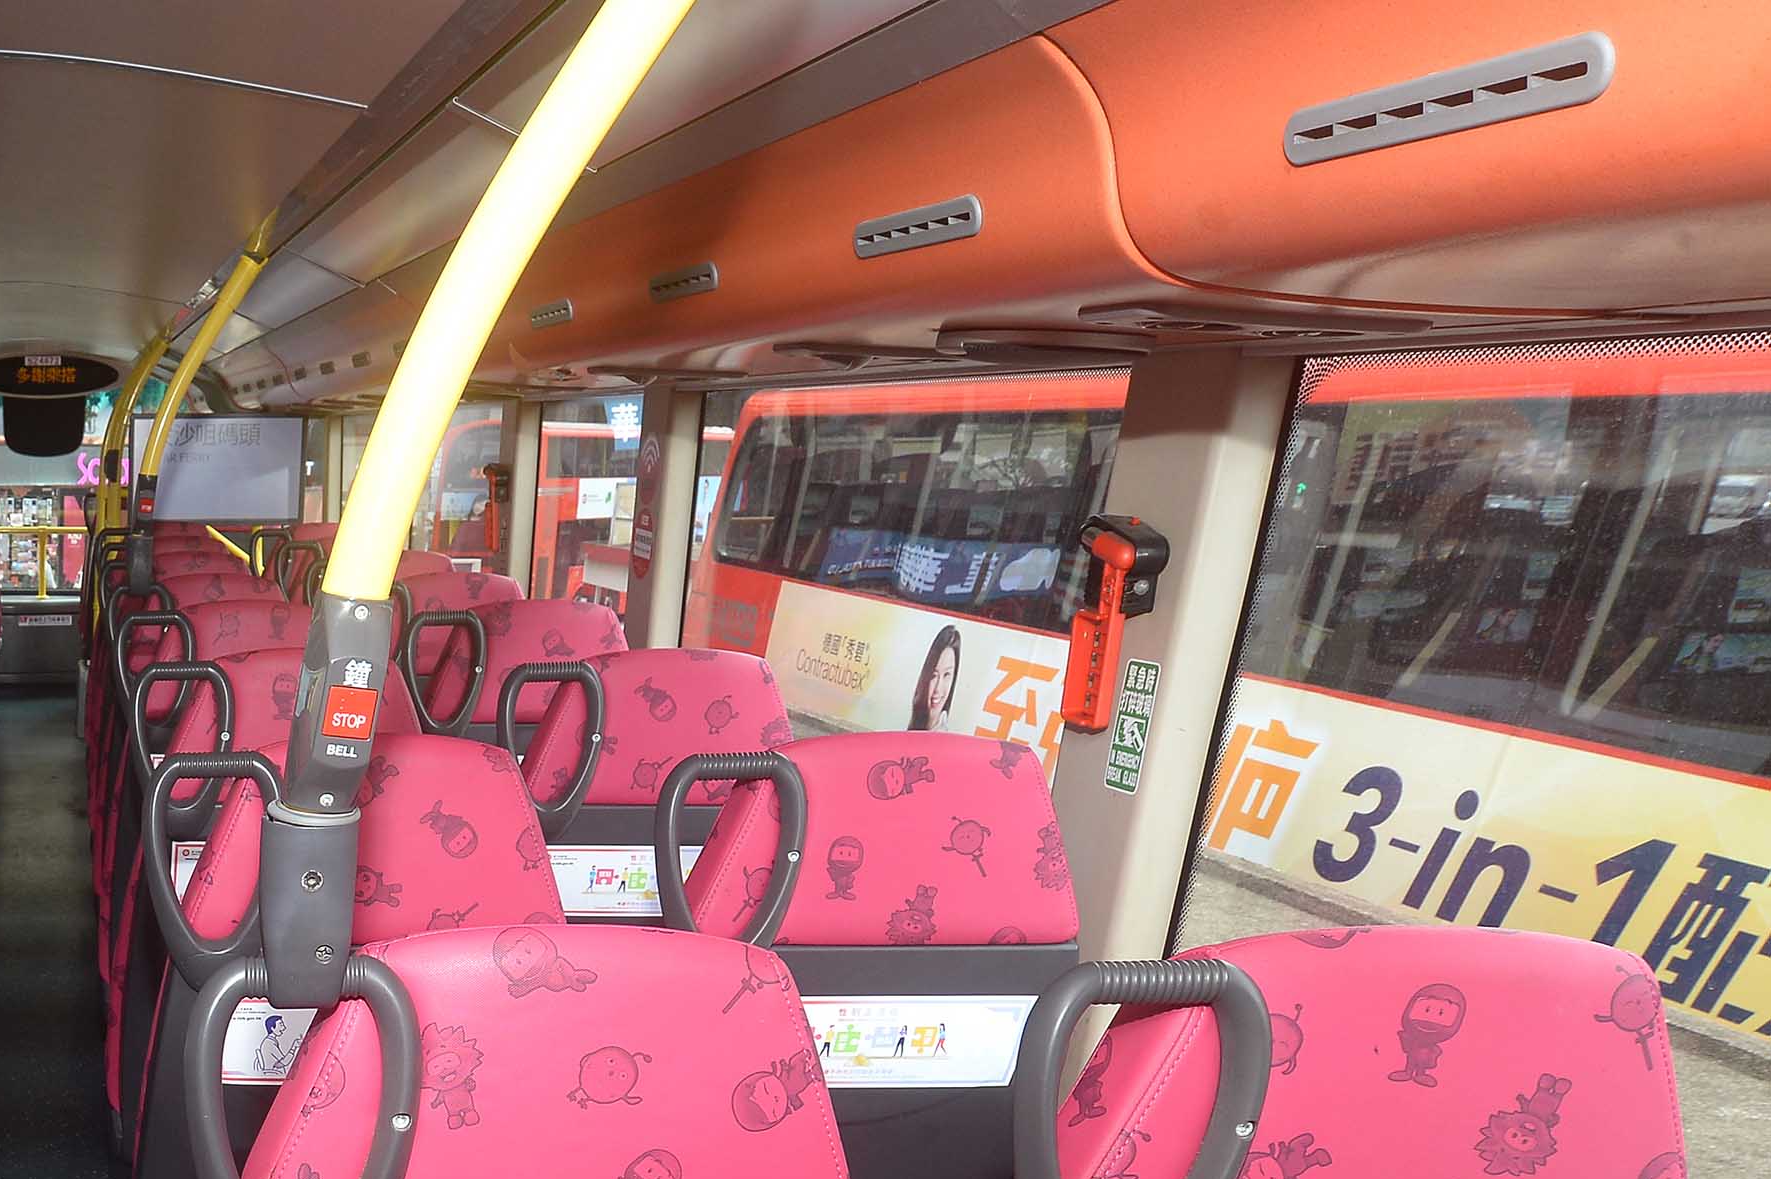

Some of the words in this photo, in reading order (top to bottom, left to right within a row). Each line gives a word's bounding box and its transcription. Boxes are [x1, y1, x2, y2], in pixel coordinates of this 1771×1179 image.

[166, 422, 261, 447] 沙咀碼頭
[77, 452, 130, 486] Saa
[343, 659, 372, 688] 鐘
[332, 712, 366, 728] STOP
[326, 744, 357, 758] BELL
